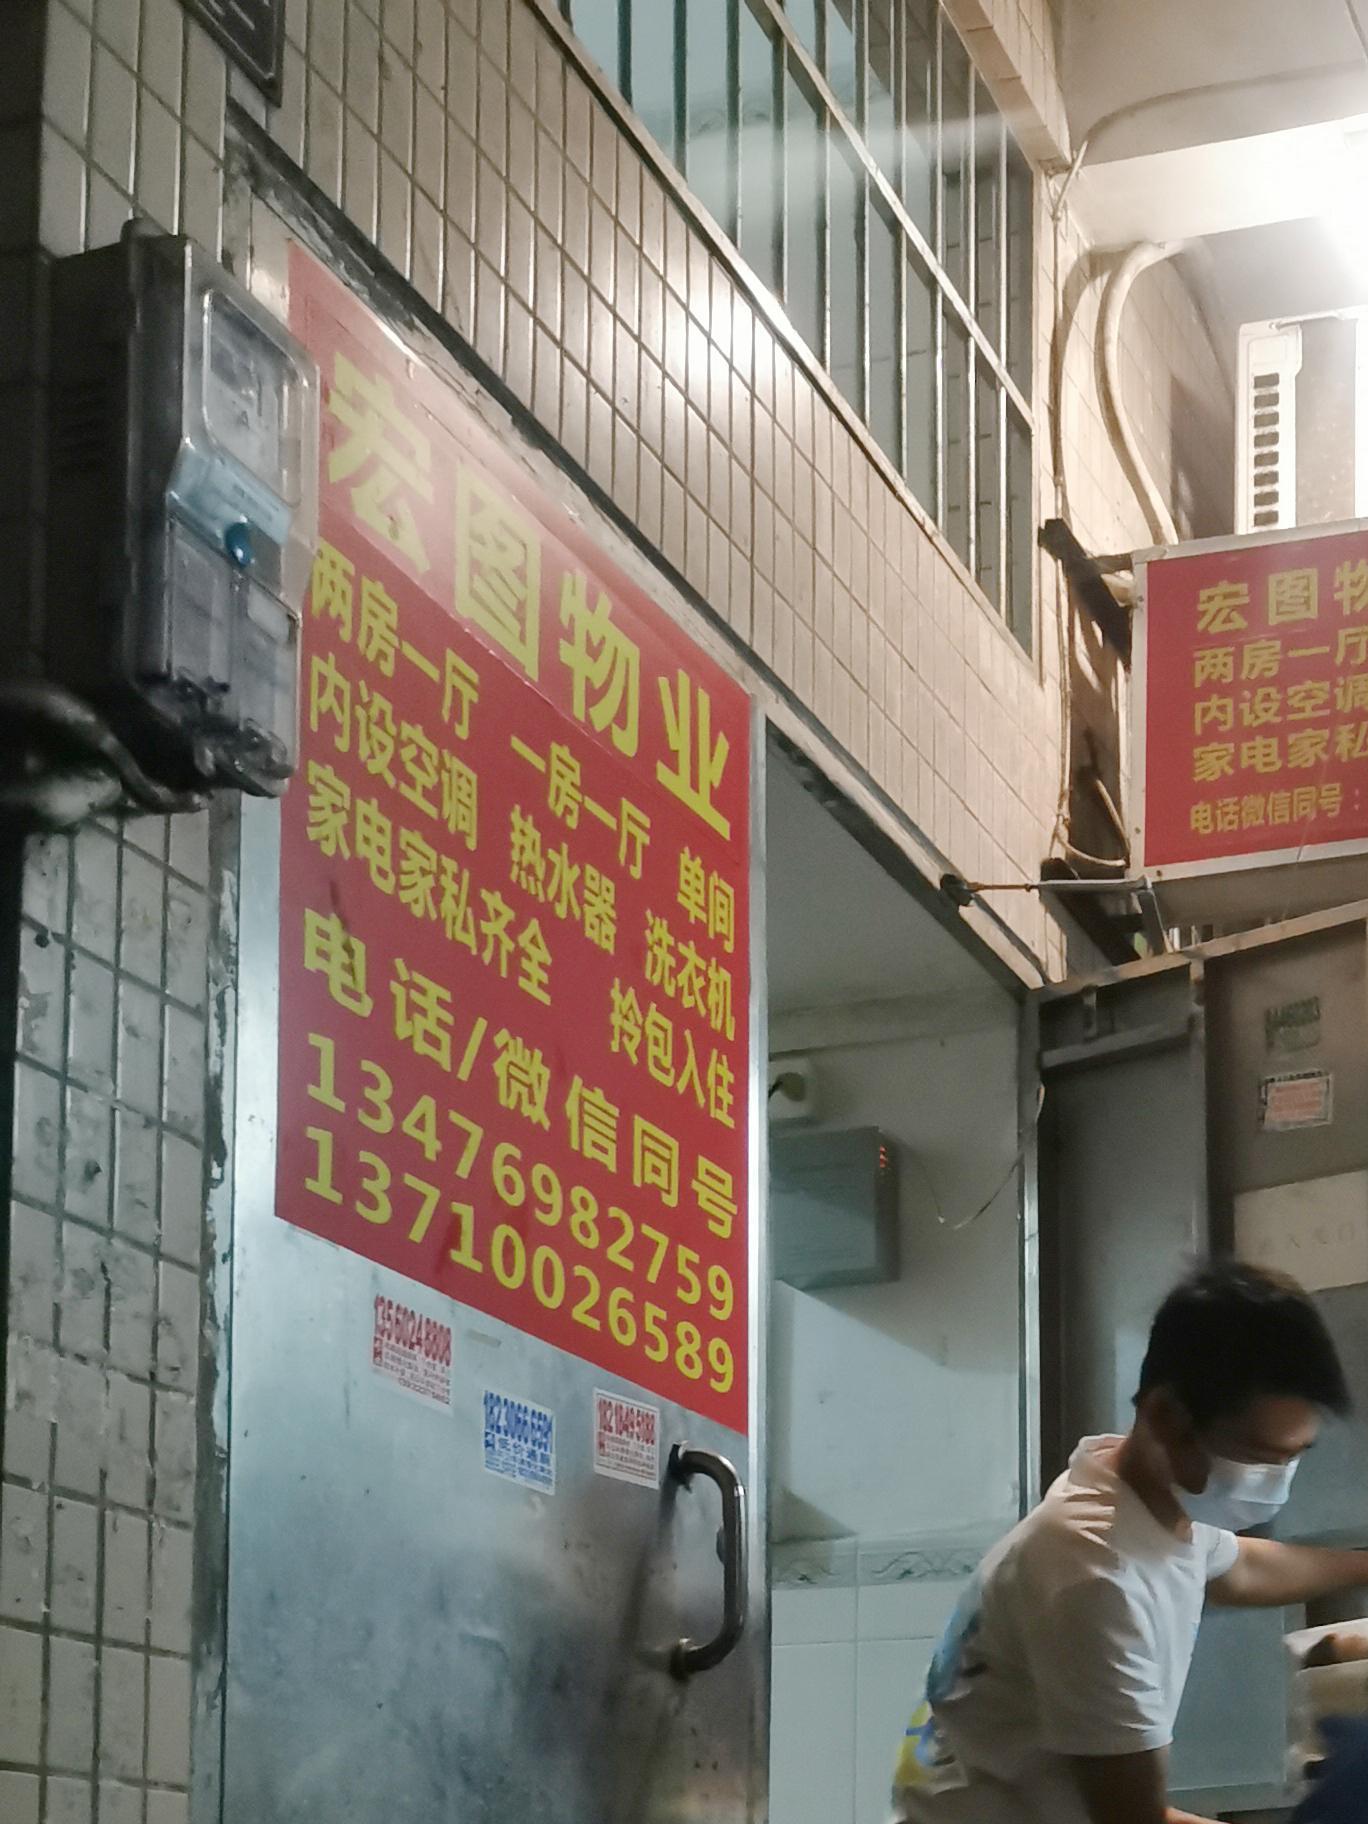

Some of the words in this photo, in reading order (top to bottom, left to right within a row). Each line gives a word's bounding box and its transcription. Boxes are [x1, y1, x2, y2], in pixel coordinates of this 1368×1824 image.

[311, 543, 479, 741] 两房一厅
[510, 735, 650, 880] 一房一厅
[677, 846, 735, 954] 单间
[328, 352, 731, 841] 宏图物业
[306, 759, 551, 1006] 家电家私齐全
[610, 977, 735, 1129] 拎包入住
[309, 652, 478, 852] 内设空调
[510, 804, 616, 955] 热水器
[644, 909, 735, 1041] 洗衣机
[304, 907, 738, 1240] 电话/微信同号
[306, 1032, 734, 1321] 13476982759
[304, 1126, 734, 1393] 13710026589
